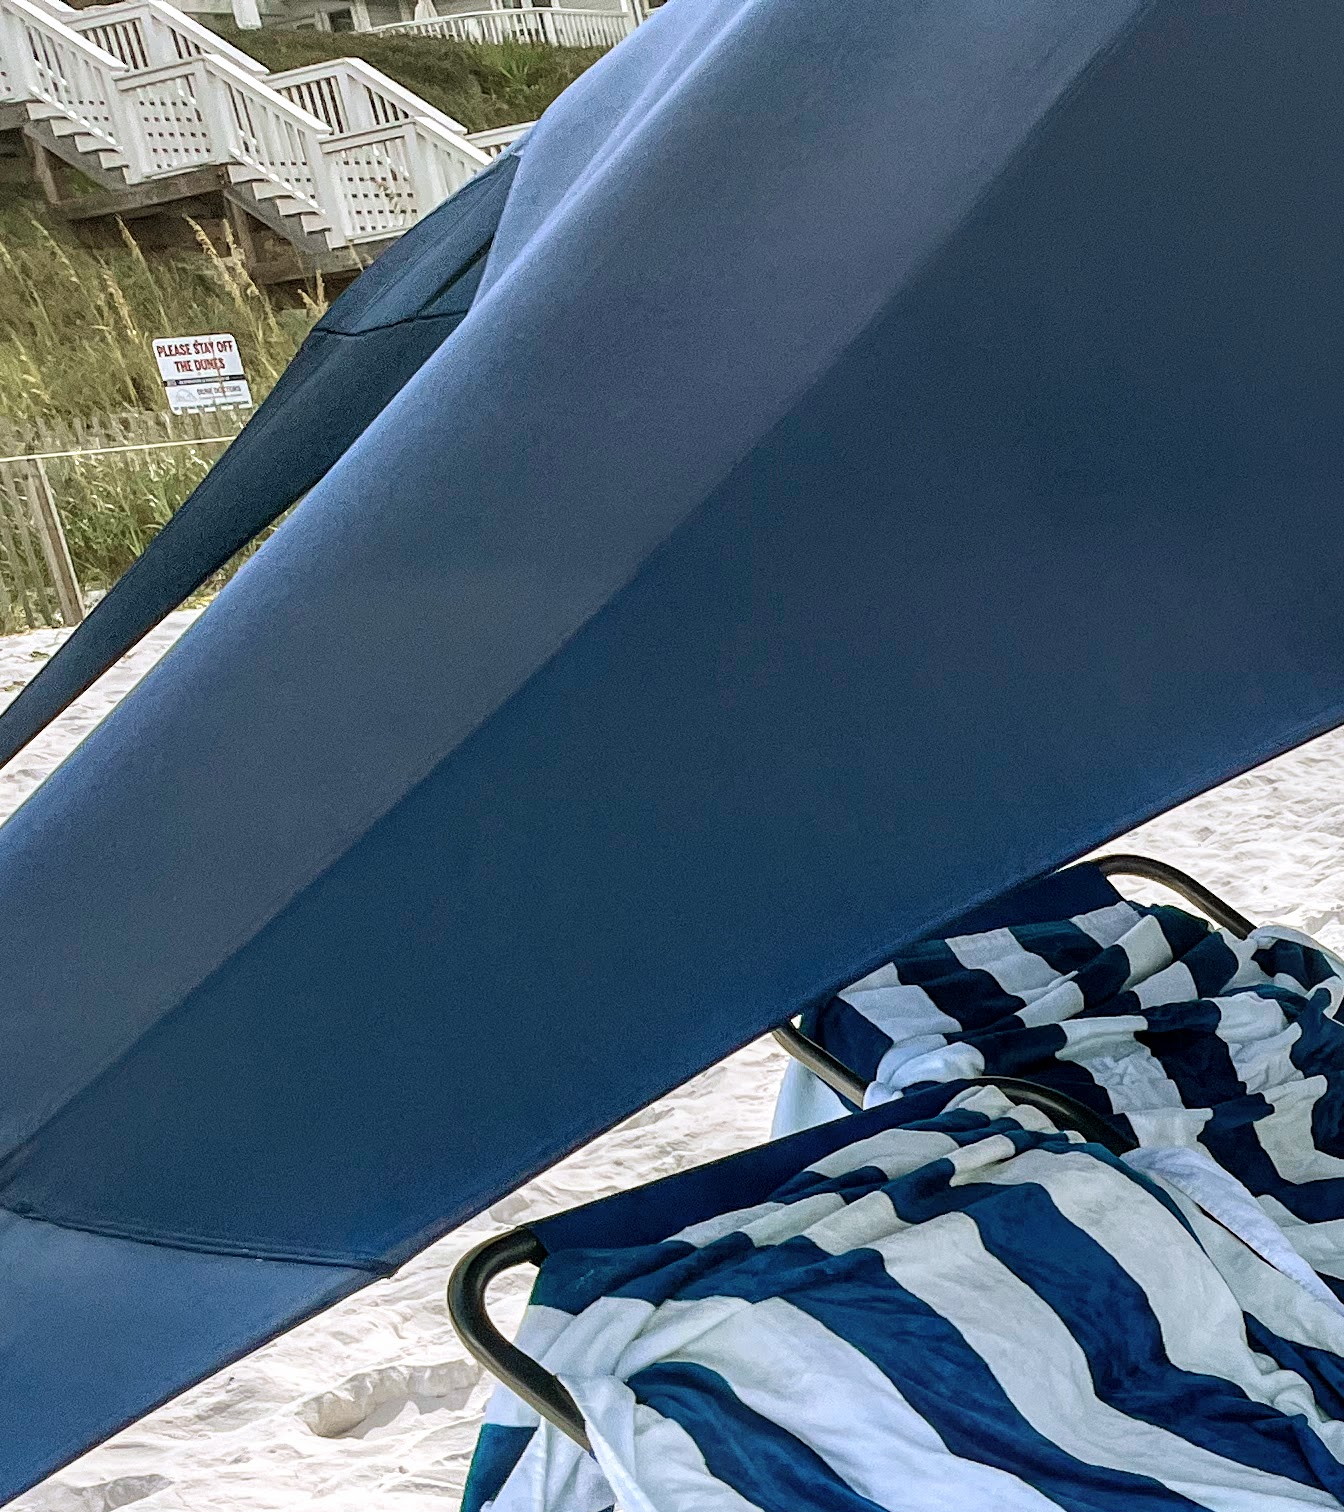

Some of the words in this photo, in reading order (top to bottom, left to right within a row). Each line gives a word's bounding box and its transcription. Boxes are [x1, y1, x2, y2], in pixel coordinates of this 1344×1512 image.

[156, 344, 192, 357] PLEASE
[193, 341, 214, 354] STAY
[216, 341, 233, 353] OFF
[174, 360, 193, 373] THE
[194, 358, 225, 370] DUNES
